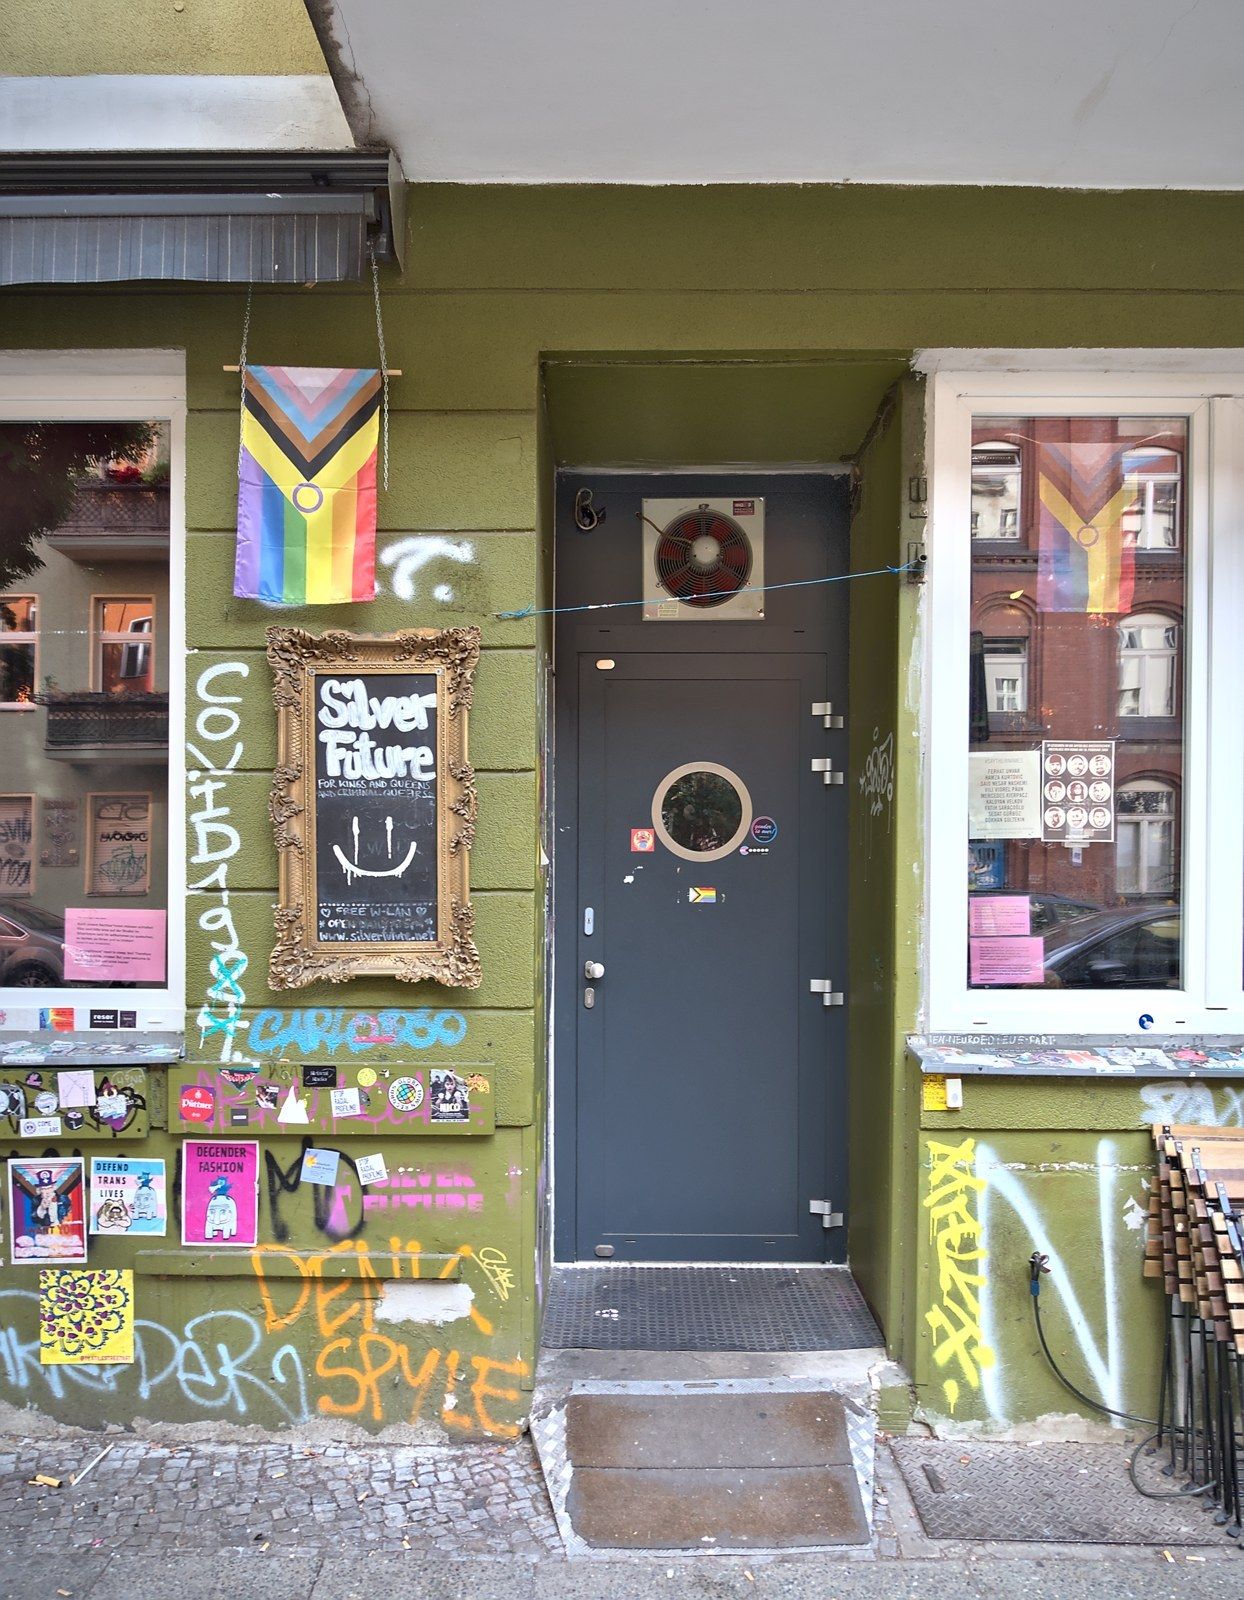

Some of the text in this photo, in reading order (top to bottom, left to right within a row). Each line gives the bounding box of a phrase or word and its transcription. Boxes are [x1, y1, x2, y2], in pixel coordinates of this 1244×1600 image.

[318, 679, 437, 732] Silver
[318, 730, 436, 781] Future
[318, 780, 431, 790] FOR KINGS AND QUEENS
[338, 789, 381, 797] CRIMINAL
[336, 907, 412, 917] FREE W-LAN
[196, 1146, 247, 1158] DEGENDER
[96, 1162, 129, 1172] DEFEND
[198, 1160, 244, 1173] FASHION
[98, 1176, 127, 1185] TRANS
[100, 1189, 124, 1198] LIVES
